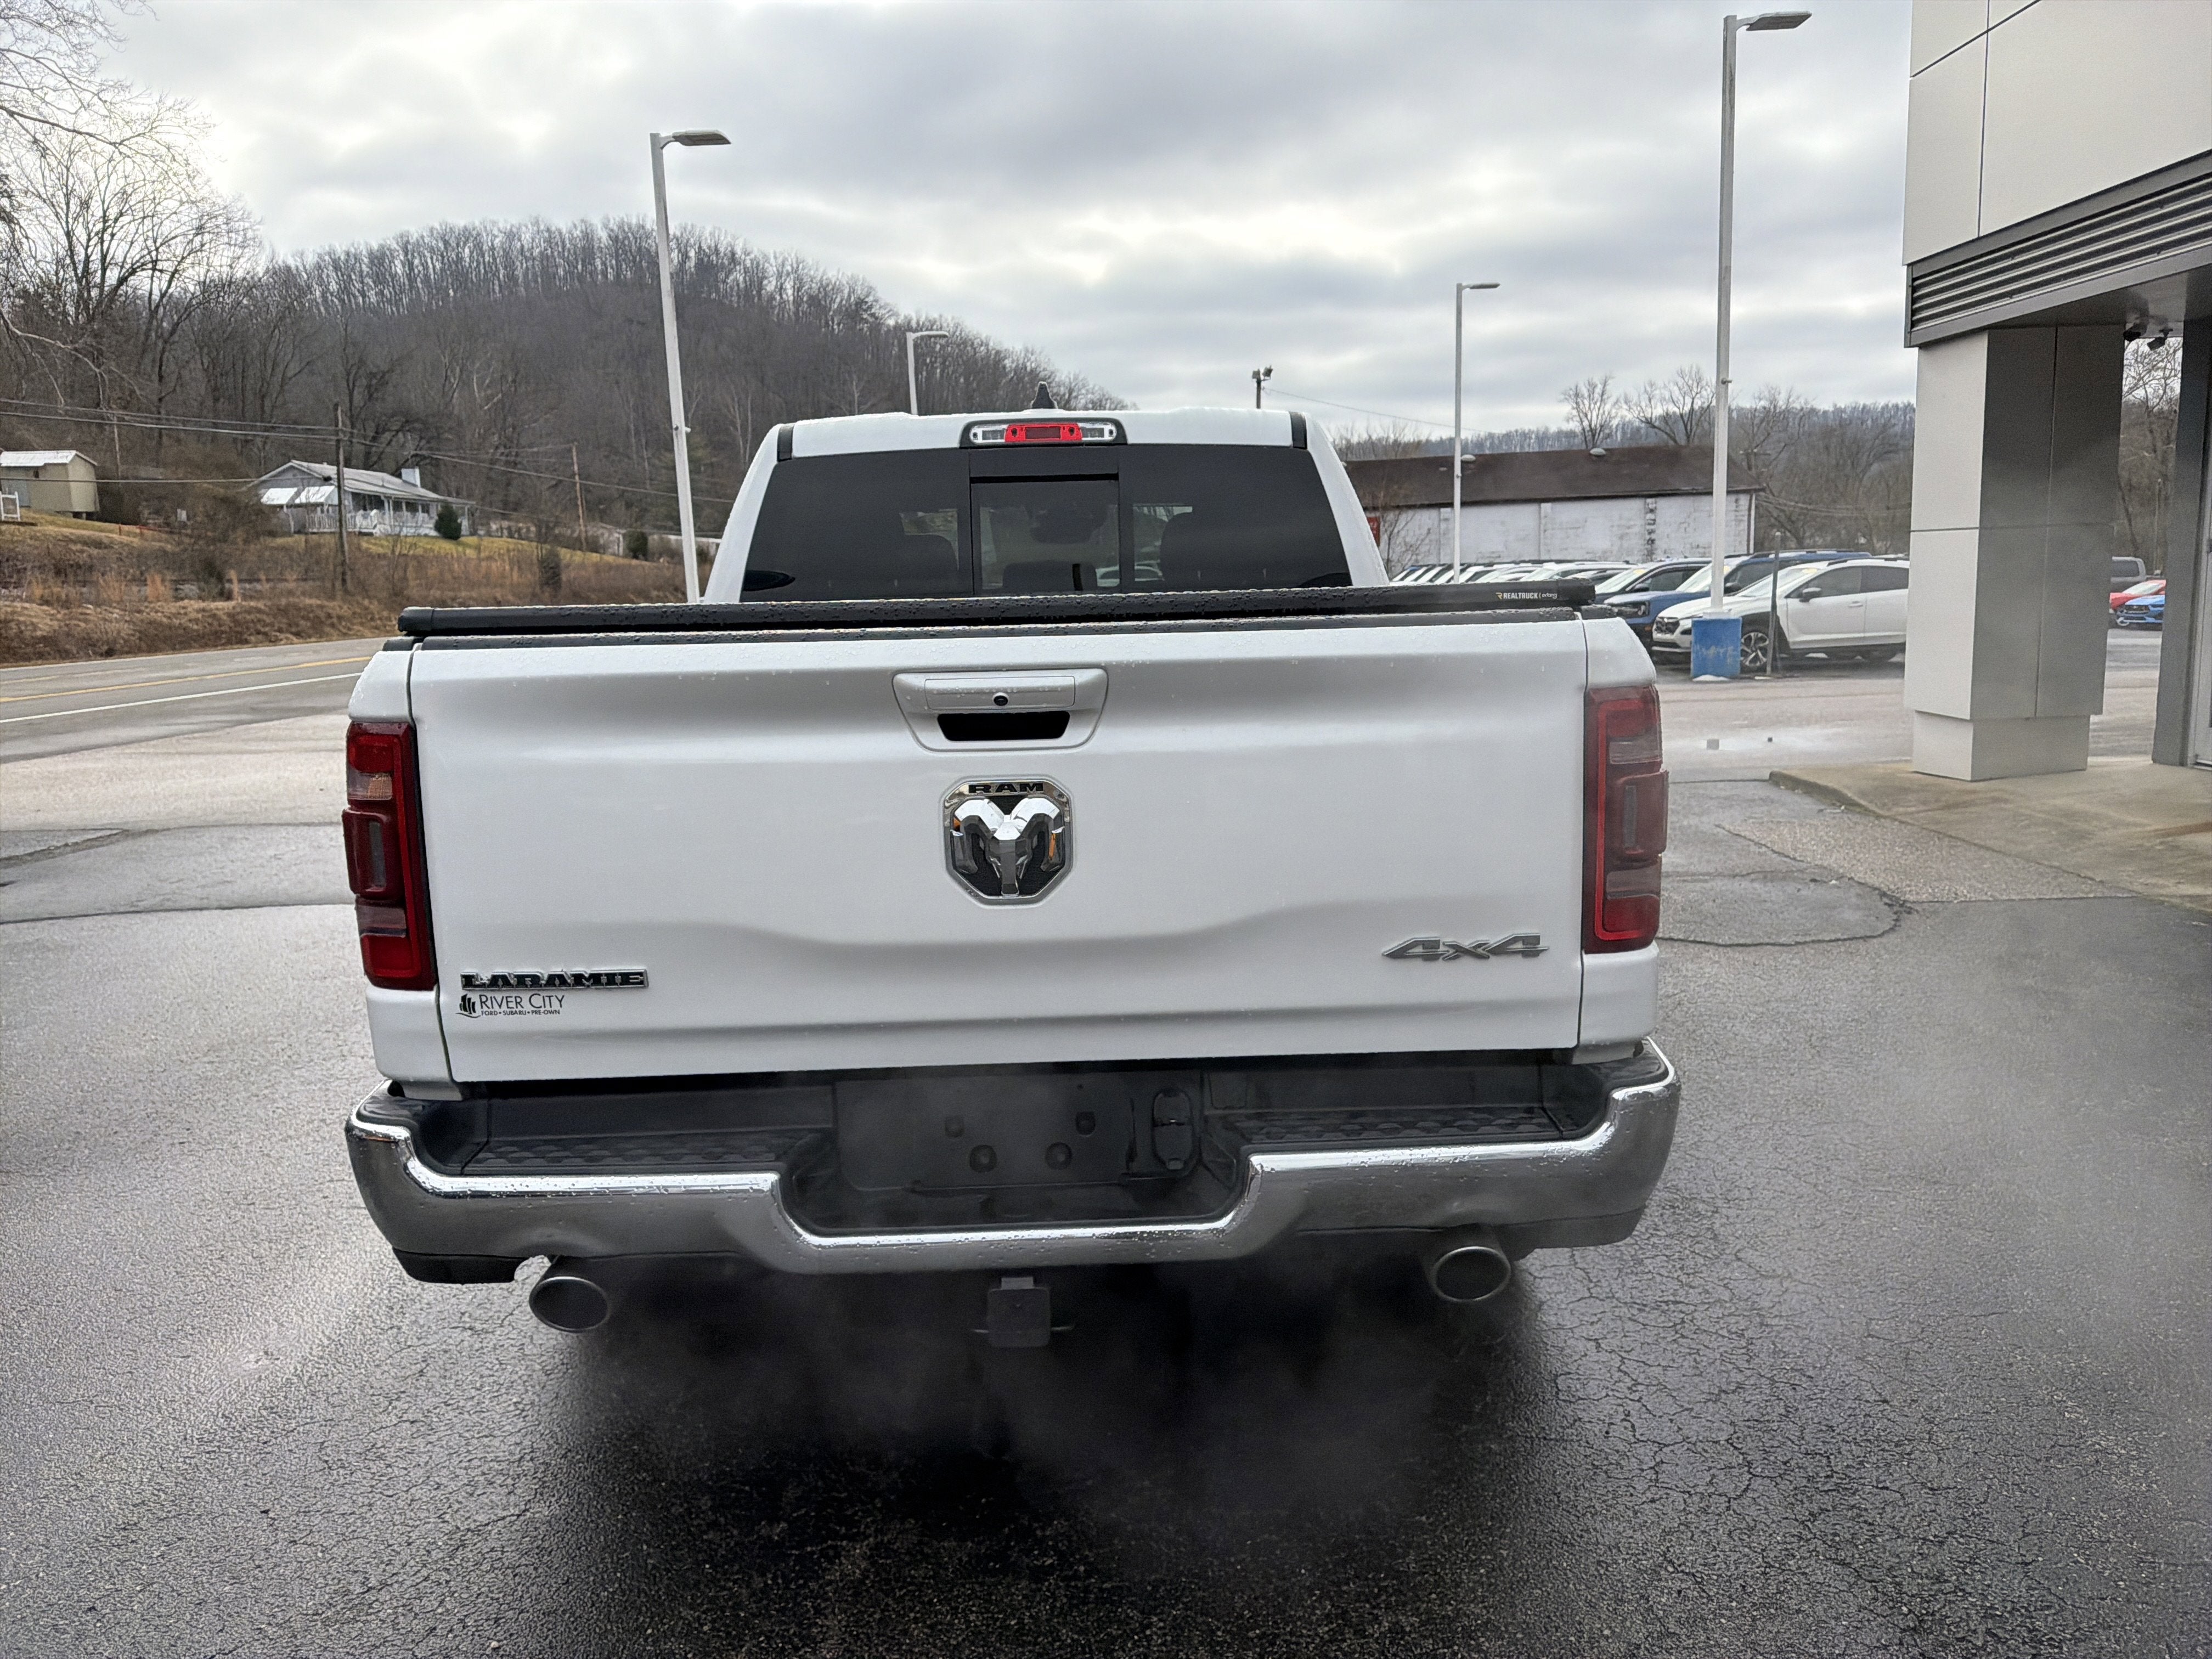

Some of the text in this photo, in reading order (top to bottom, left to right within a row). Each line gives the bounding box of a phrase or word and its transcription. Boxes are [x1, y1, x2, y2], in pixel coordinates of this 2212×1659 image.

[968, 783, 1044, 794] RAM
[460, 968, 649, 990] LARAMIE
[479, 993, 565, 1009] RIVER CITY
